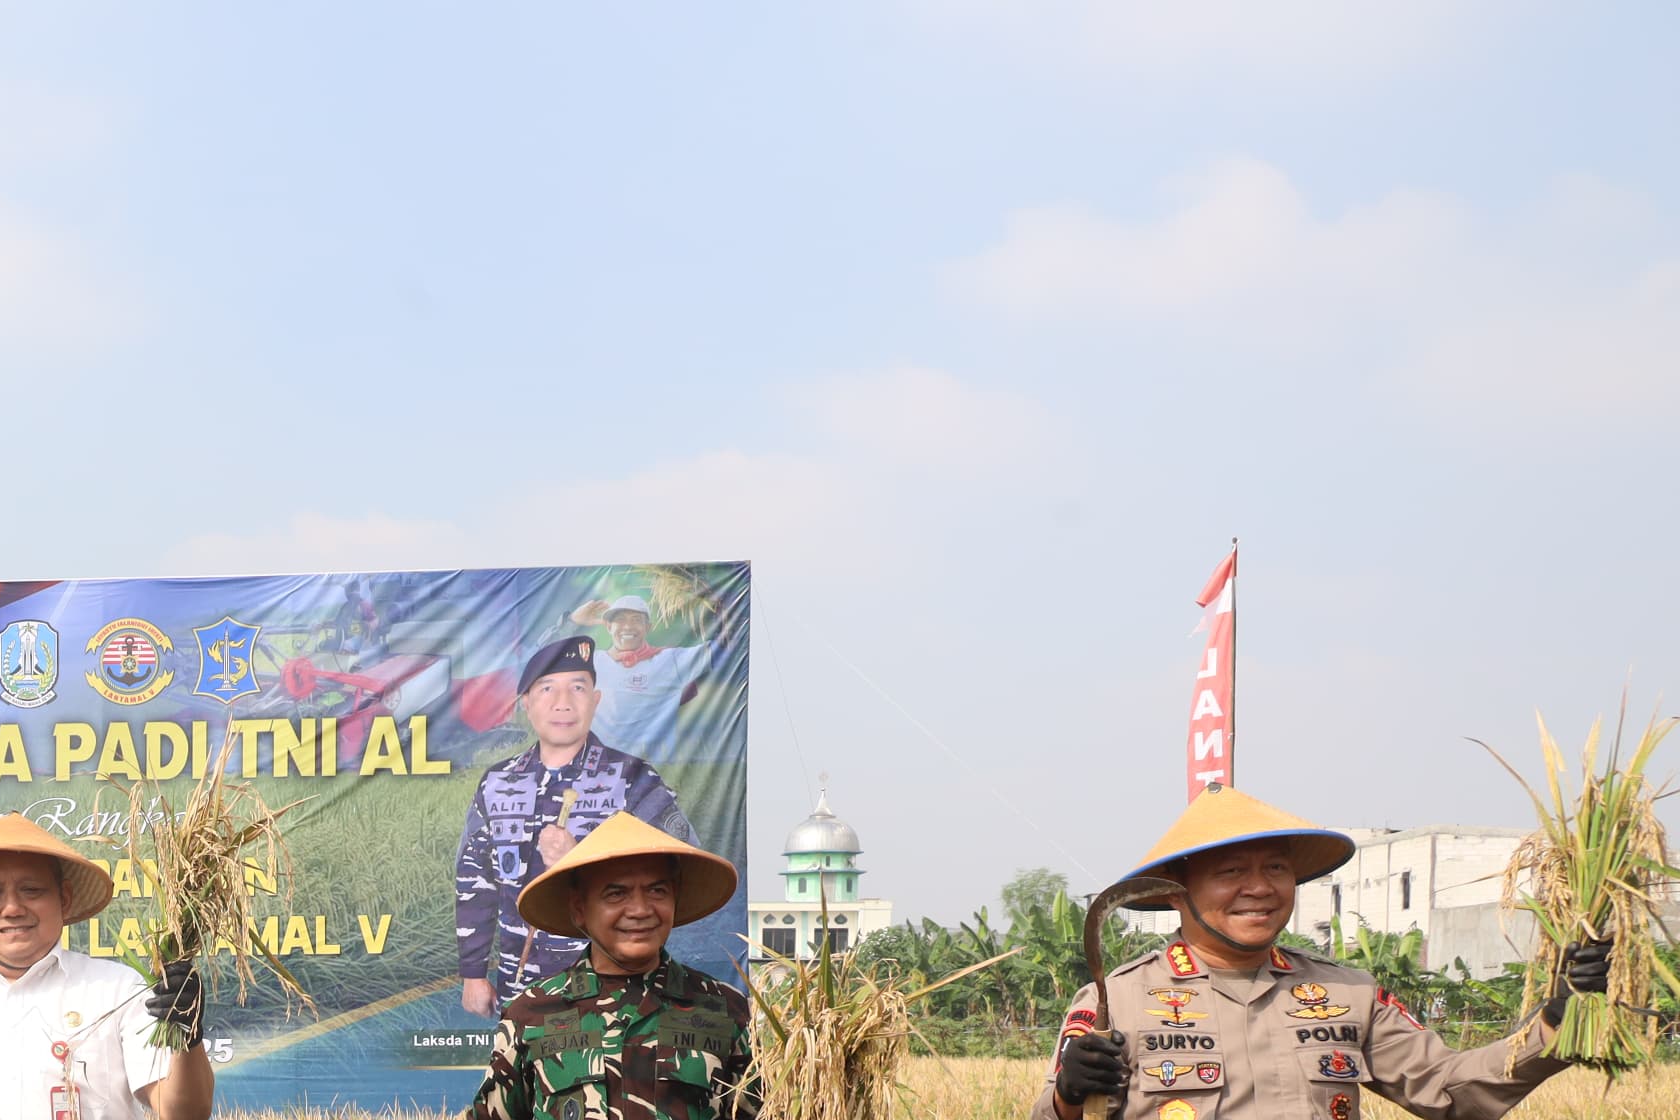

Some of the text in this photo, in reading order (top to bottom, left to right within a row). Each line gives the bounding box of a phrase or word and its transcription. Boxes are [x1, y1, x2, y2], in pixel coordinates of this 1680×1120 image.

[53, 720, 208, 782] PADI
[231, 717, 337, 778] TNI
[359, 715, 451, 776] AL
[490, 802, 527, 814] ALIT
[575, 798, 618, 810] TNI AL
[357, 914, 393, 955] V
[413, 1034, 462, 1047] Laksda
[466, 1034, 489, 1046] TNI
[672, 1031, 695, 1047] TNI
[1145, 1034, 1215, 1051] SURYO
[1296, 1025, 1359, 1044] POLRI
[541, 1033, 590, 1056] FAJAR
